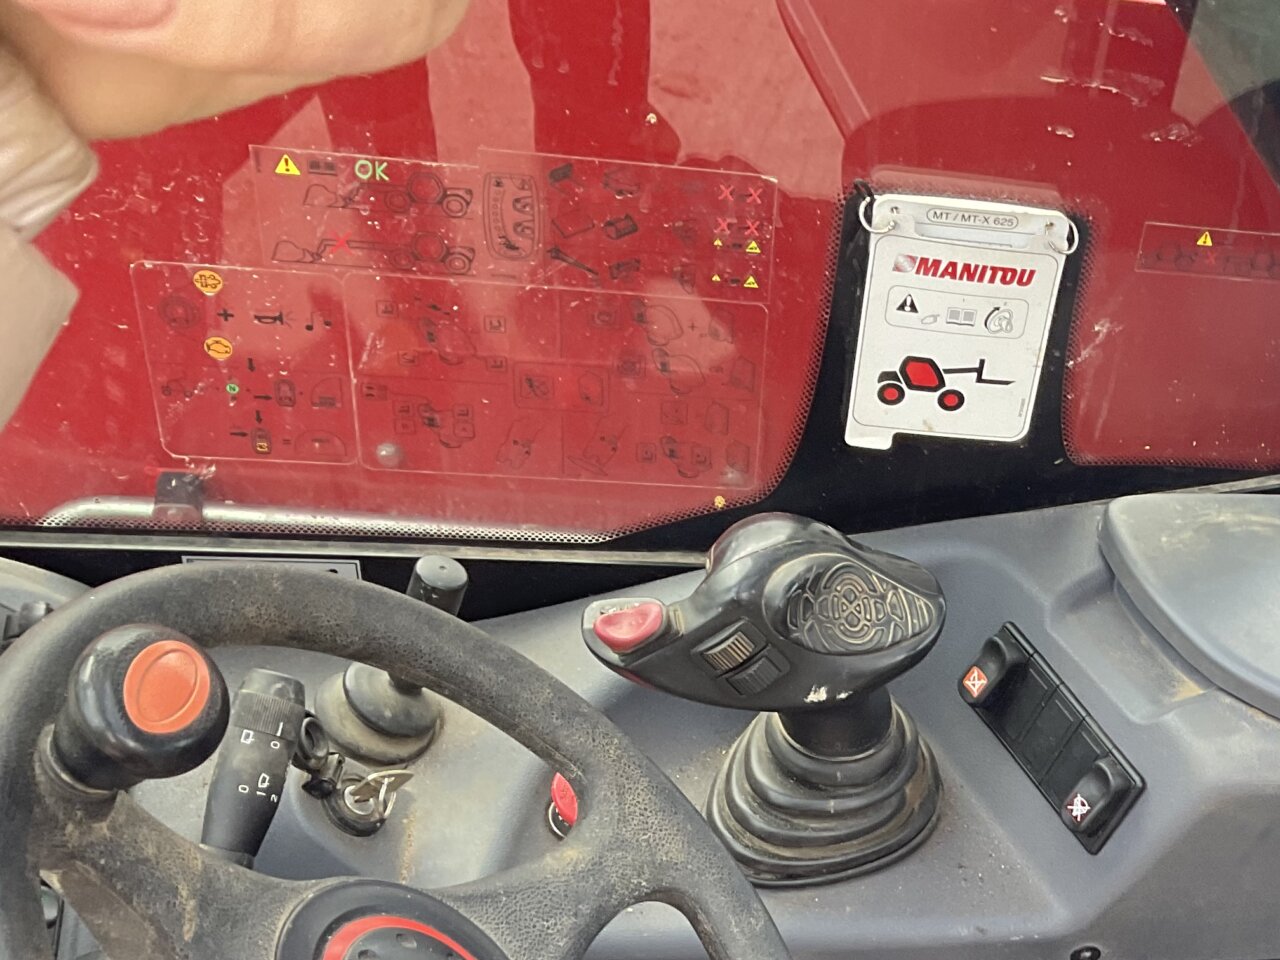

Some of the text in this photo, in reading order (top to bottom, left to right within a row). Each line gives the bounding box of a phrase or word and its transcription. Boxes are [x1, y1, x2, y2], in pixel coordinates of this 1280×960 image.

[354, 159, 389, 181] OK
[932, 210, 951, 221] MT
[961, 213, 991, 225] MT-X
[993, 216, 1014, 227] 625
[914, 256, 1037, 288] MANITOU
